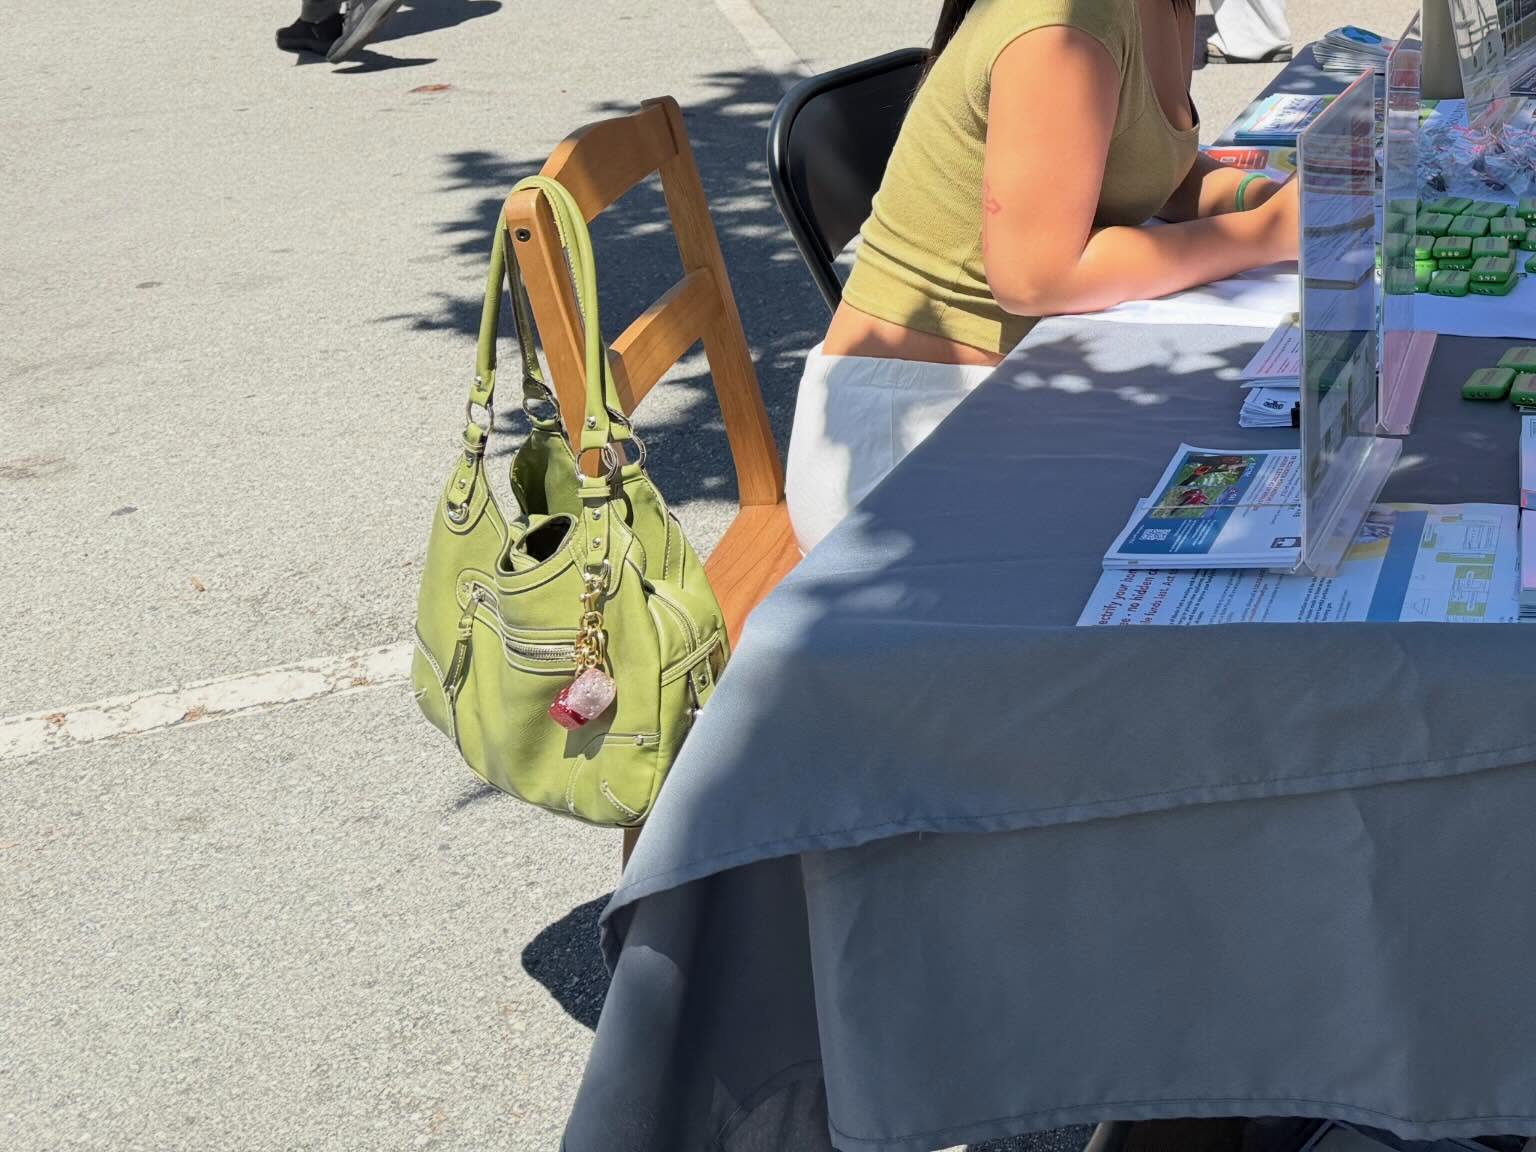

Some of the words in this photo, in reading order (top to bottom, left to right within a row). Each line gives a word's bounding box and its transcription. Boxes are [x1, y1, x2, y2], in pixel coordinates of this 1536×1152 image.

[1114, 581, 1128, 600] your
[1128, 601, 1140, 614] no
[1134, 578, 1152, 604] hidden
